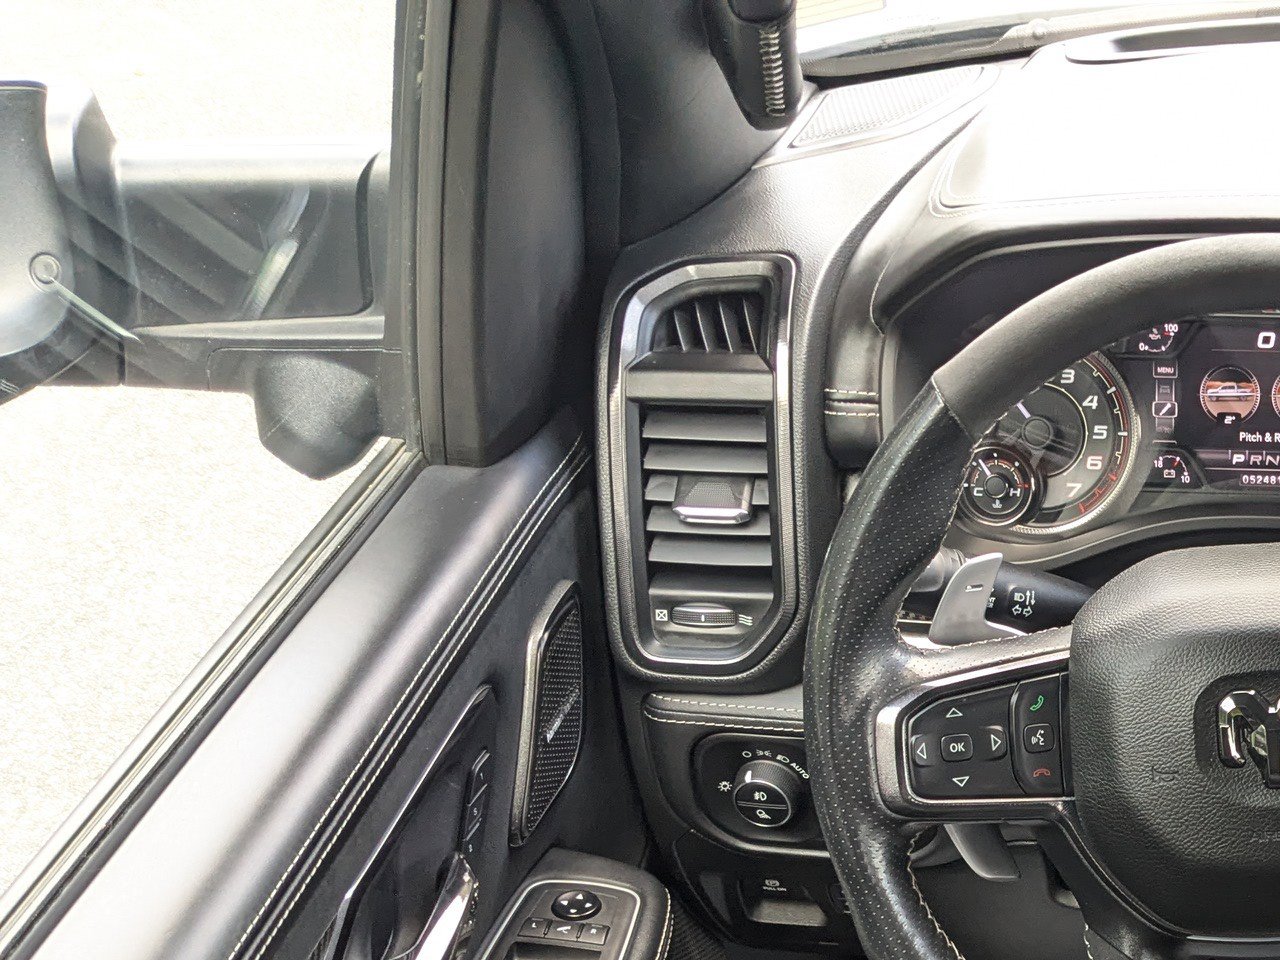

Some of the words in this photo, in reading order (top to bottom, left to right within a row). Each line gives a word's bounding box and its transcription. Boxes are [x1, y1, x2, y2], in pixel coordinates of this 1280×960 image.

[1164, 324, 1178, 332] 100
[1258, 332, 1276, 348] 0
[1139, 343, 1145, 351] 0
[1061, 369, 1075, 383] 3
[1083, 396, 1098, 409] 4
[1093, 426, 1107, 439] 5
[1240, 432, 1262, 442] Pitch
[1265, 433, 1272, 442] &
[1087, 456, 1102, 470] 6
[1181, 476, 1190, 484] 10
[974, 488, 983, 496] C
[1010, 488, 1021, 496] H
[1067, 483, 1082, 497] 7
[950, 742, 965, 753] OK
[790, 762, 810, 779] AUTO
